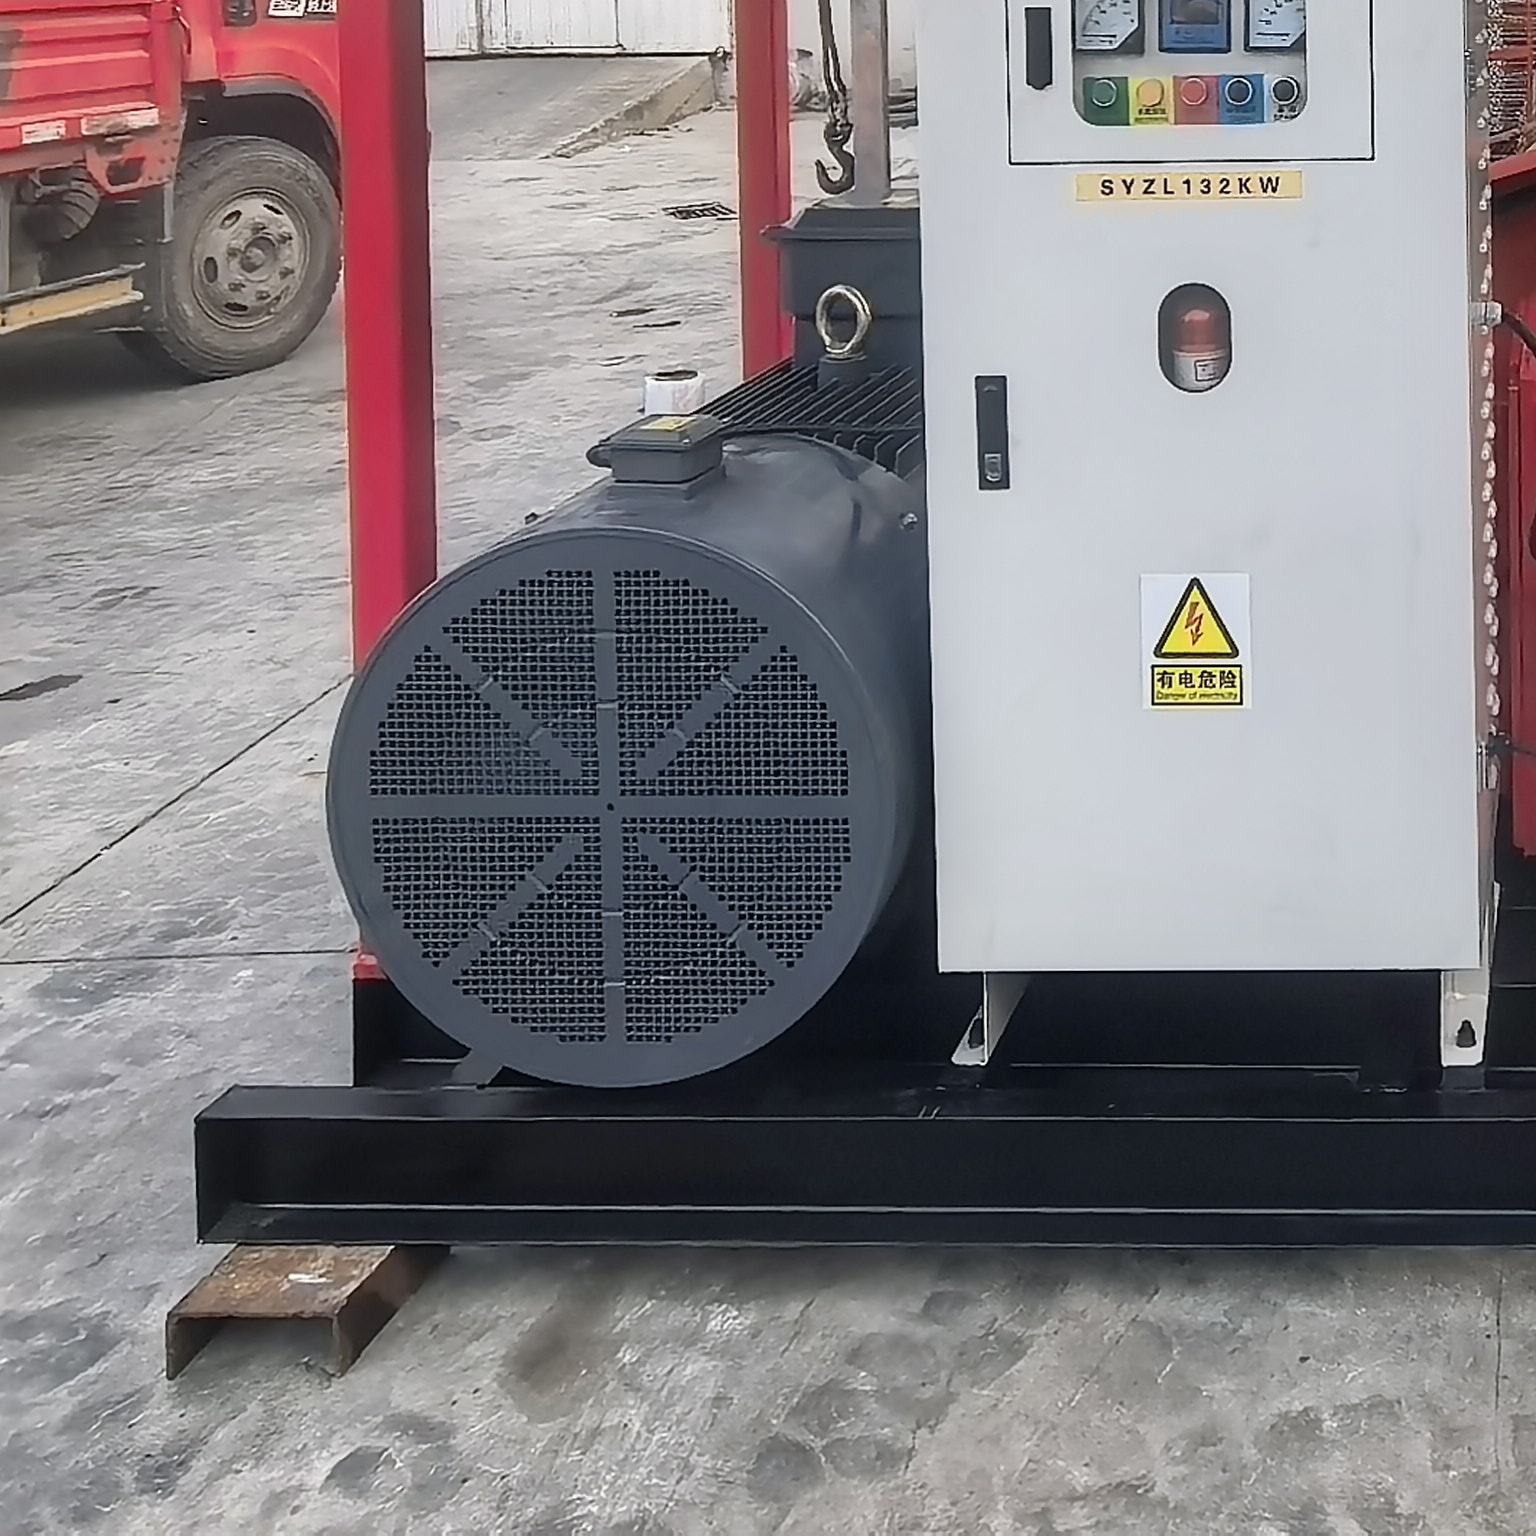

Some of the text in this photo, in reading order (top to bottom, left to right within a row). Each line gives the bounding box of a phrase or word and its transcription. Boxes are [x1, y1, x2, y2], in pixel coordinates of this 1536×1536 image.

[1100, 176, 1280, 195] SYZL132KW
[1155, 669, 1237, 689] 有电危险
